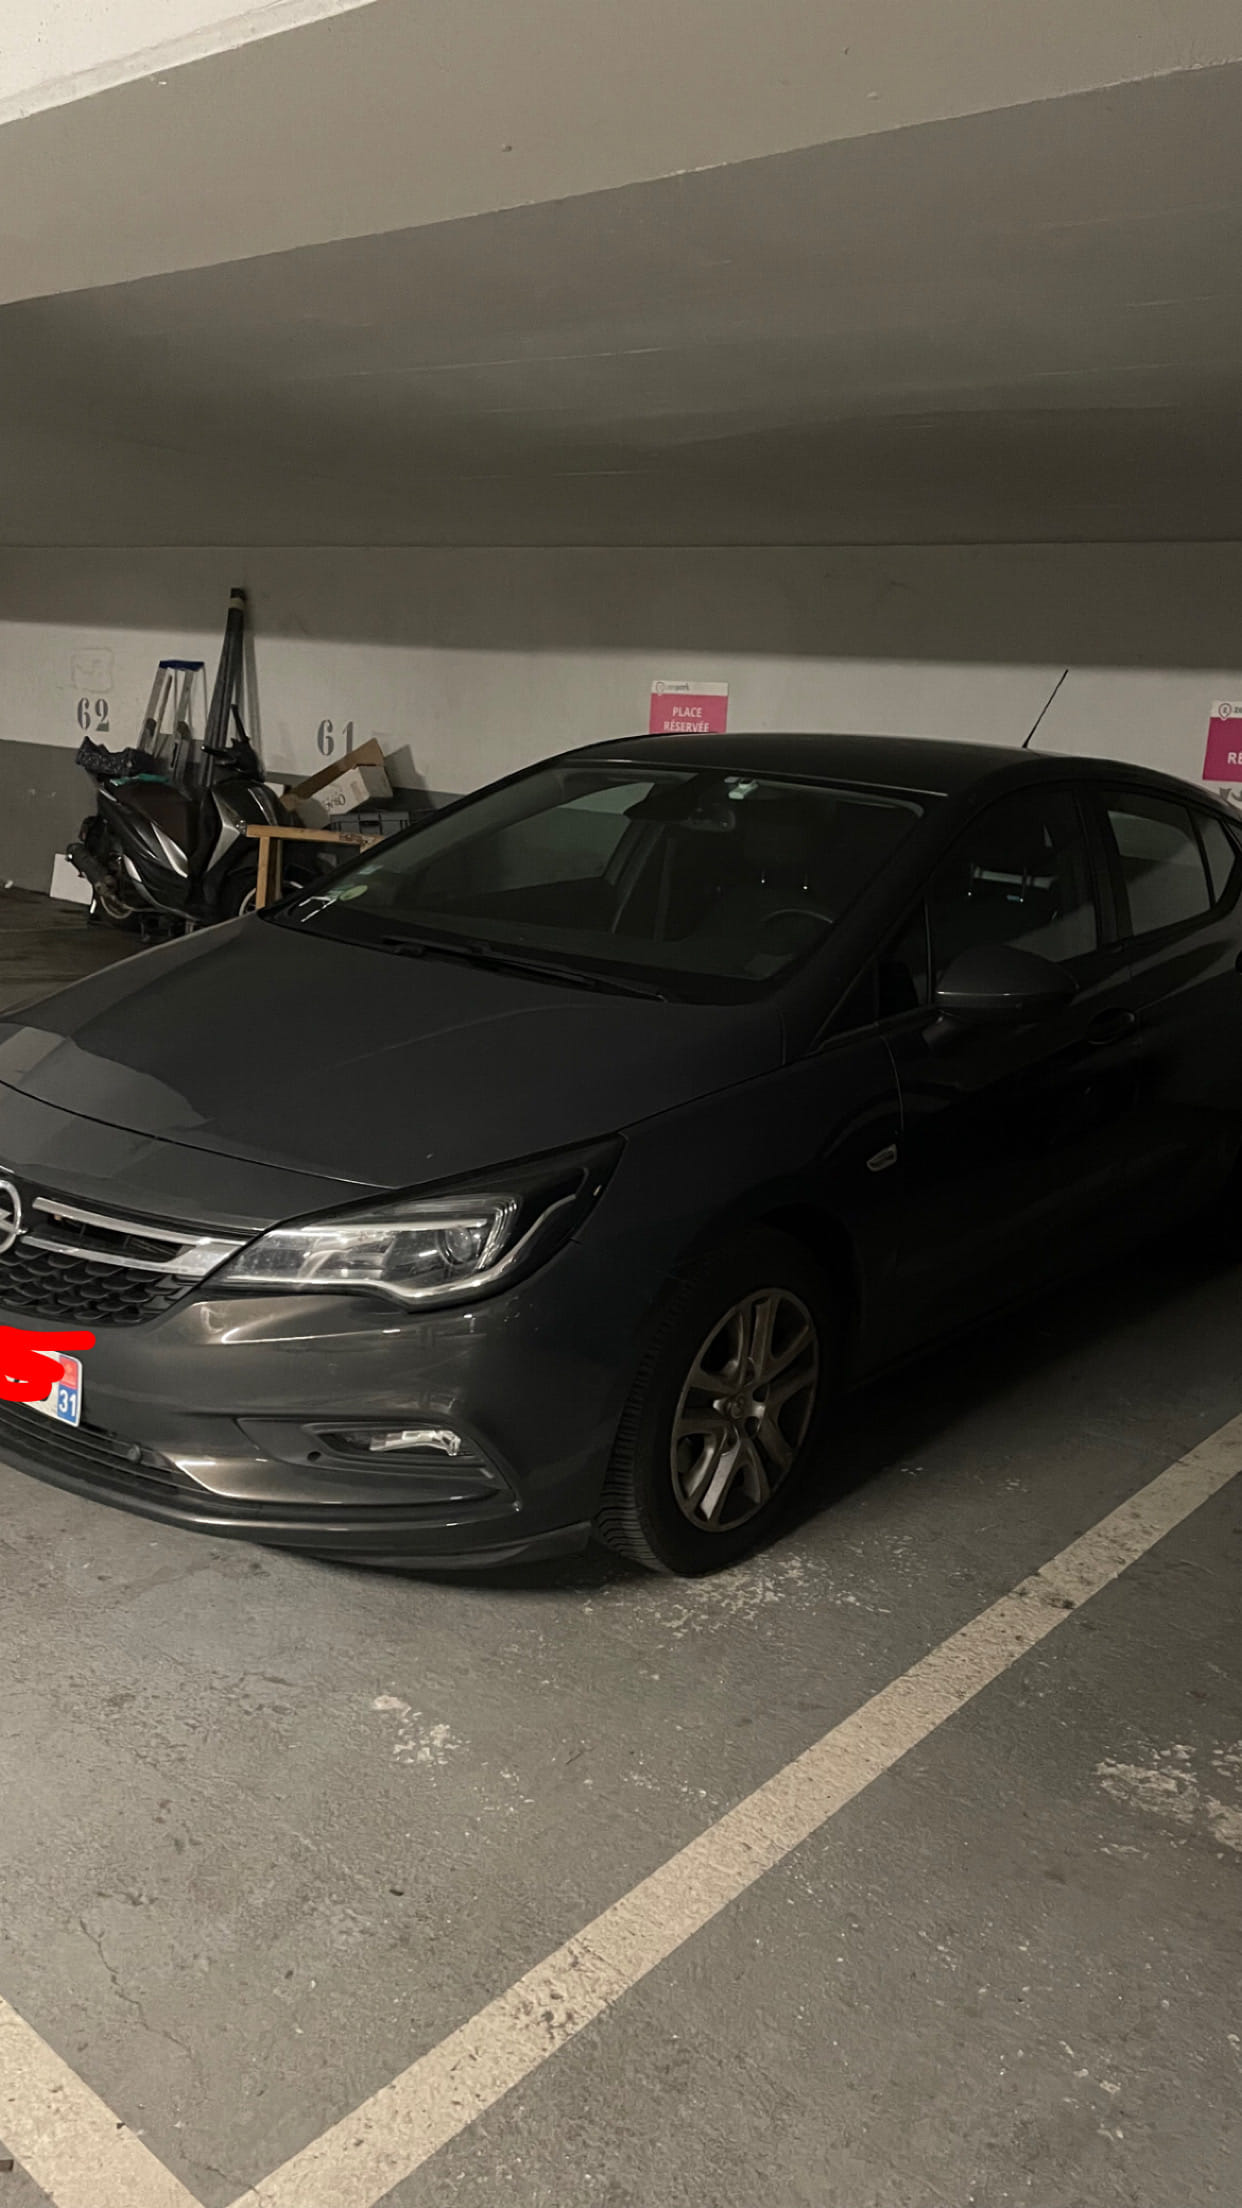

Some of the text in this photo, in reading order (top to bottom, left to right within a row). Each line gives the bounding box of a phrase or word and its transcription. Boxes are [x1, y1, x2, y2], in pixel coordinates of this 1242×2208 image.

[77, 697, 110, 732] 62
[672, 706, 703, 718] PLACE
[317, 719, 354, 757] 61
[58, 1389, 77, 1417] 31
